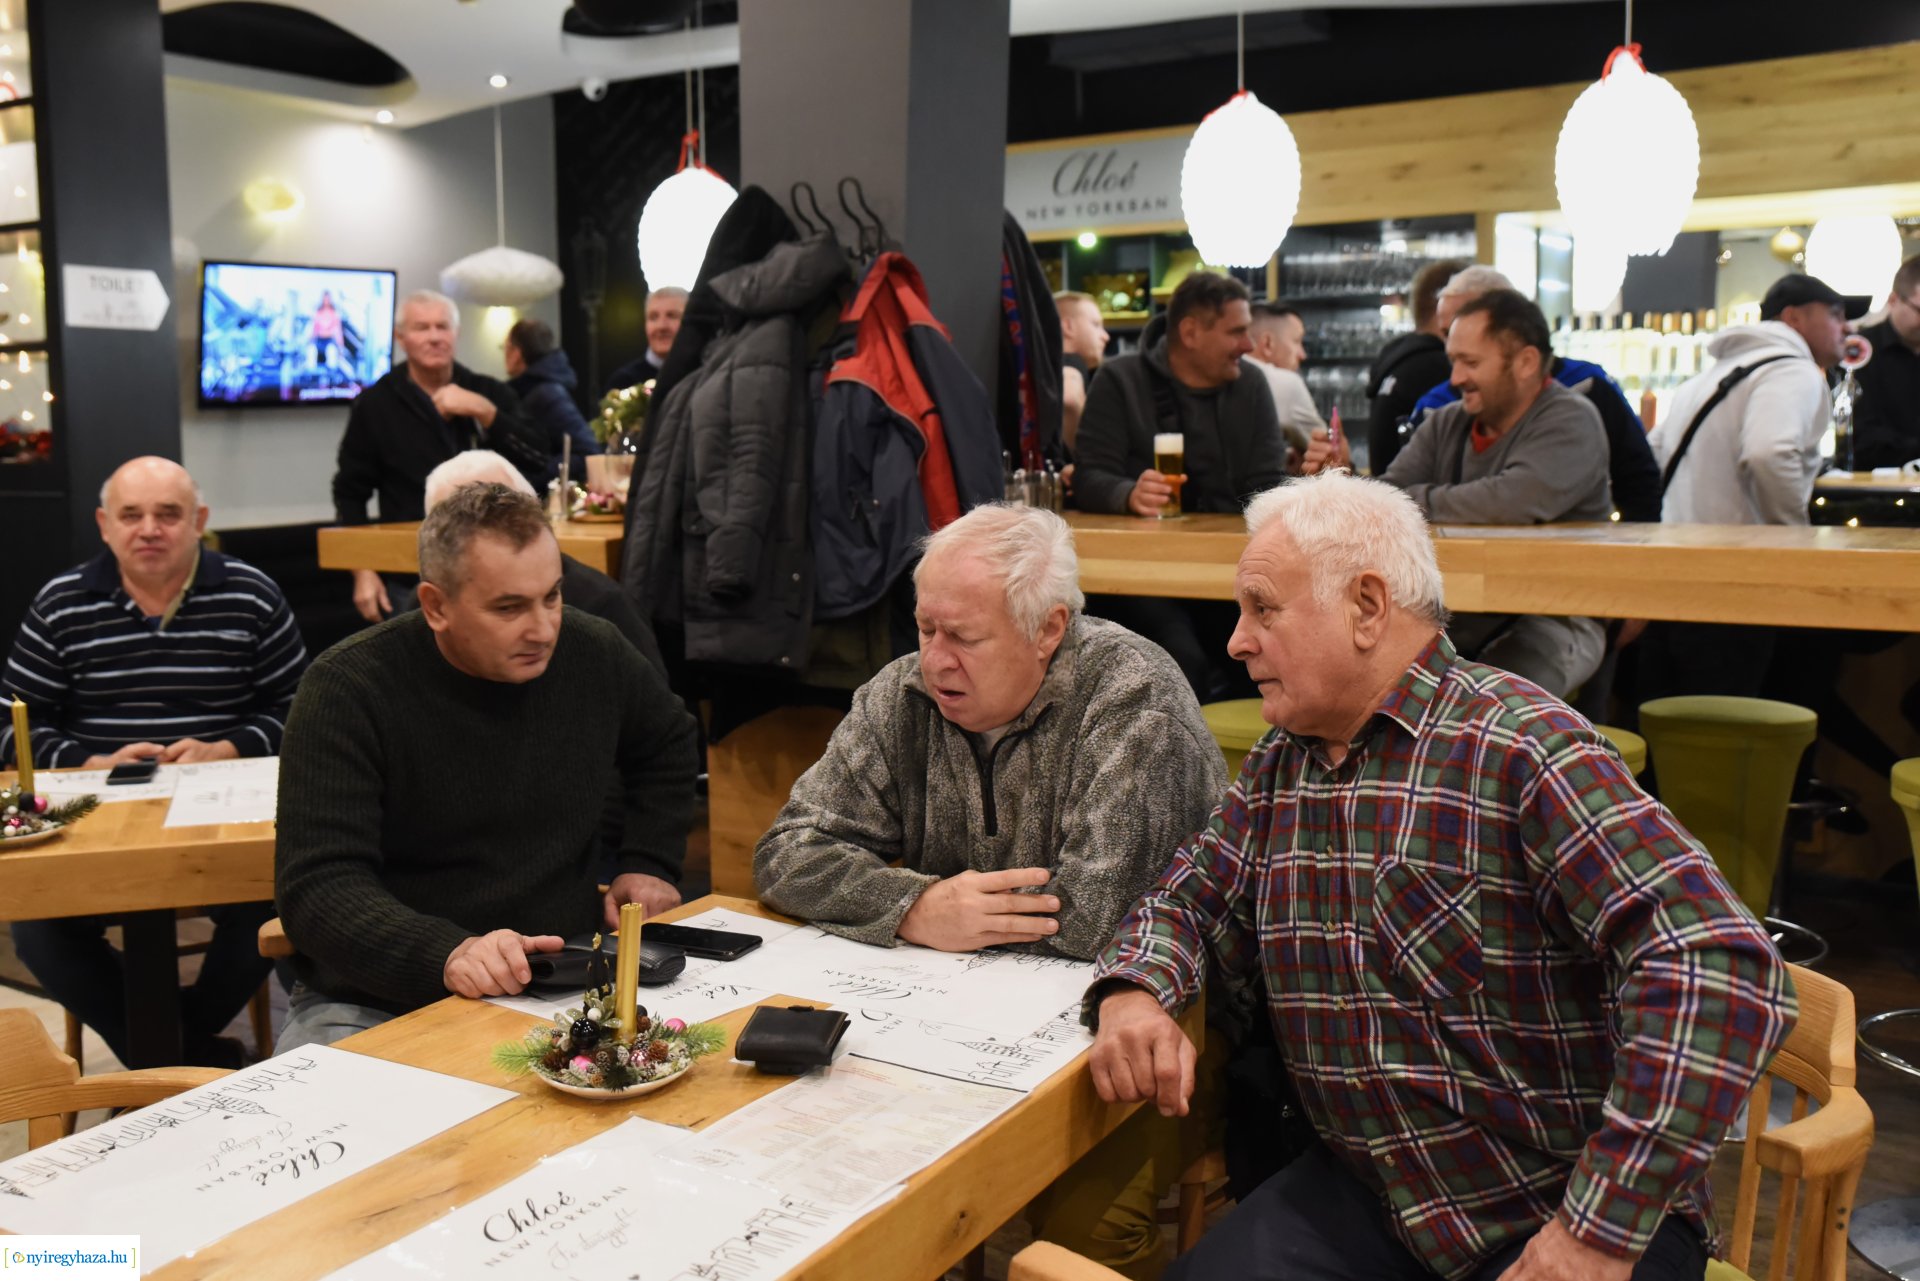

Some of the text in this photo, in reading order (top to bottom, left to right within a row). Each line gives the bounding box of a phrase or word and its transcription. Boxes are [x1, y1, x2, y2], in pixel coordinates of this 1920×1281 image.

[1052, 149, 1138, 198] Chloé
[1026, 197, 1168, 220] NEW YORKBAN
[663, 982, 710, 1000] RKBAN
[822, 969, 901, 988] YORKBAN
[907, 985, 948, 995] NEW
[196, 1122, 348, 1191] NEW YORKBAN
[251, 1141, 345, 1186] Chloé
[484, 1191, 576, 1242] Chloé
[484, 1186, 628, 1267] NEW YORKBAN
